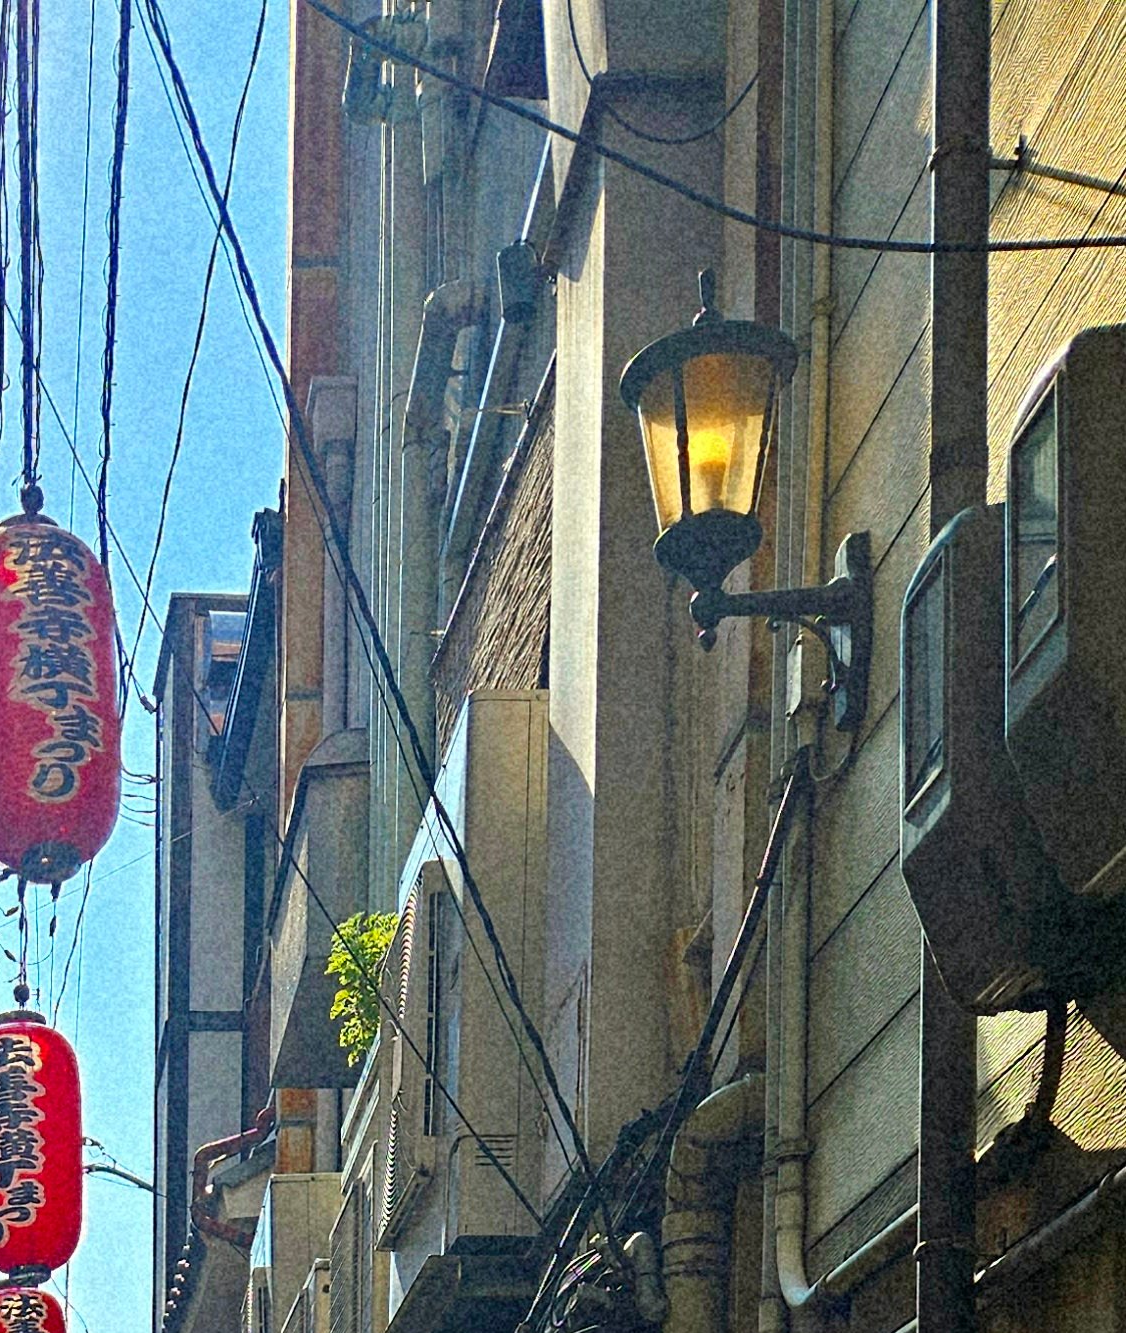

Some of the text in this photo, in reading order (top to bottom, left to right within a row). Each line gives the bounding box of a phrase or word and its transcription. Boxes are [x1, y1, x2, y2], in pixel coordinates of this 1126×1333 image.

[5, 531, 103, 801] 法善寺横丁まつり
